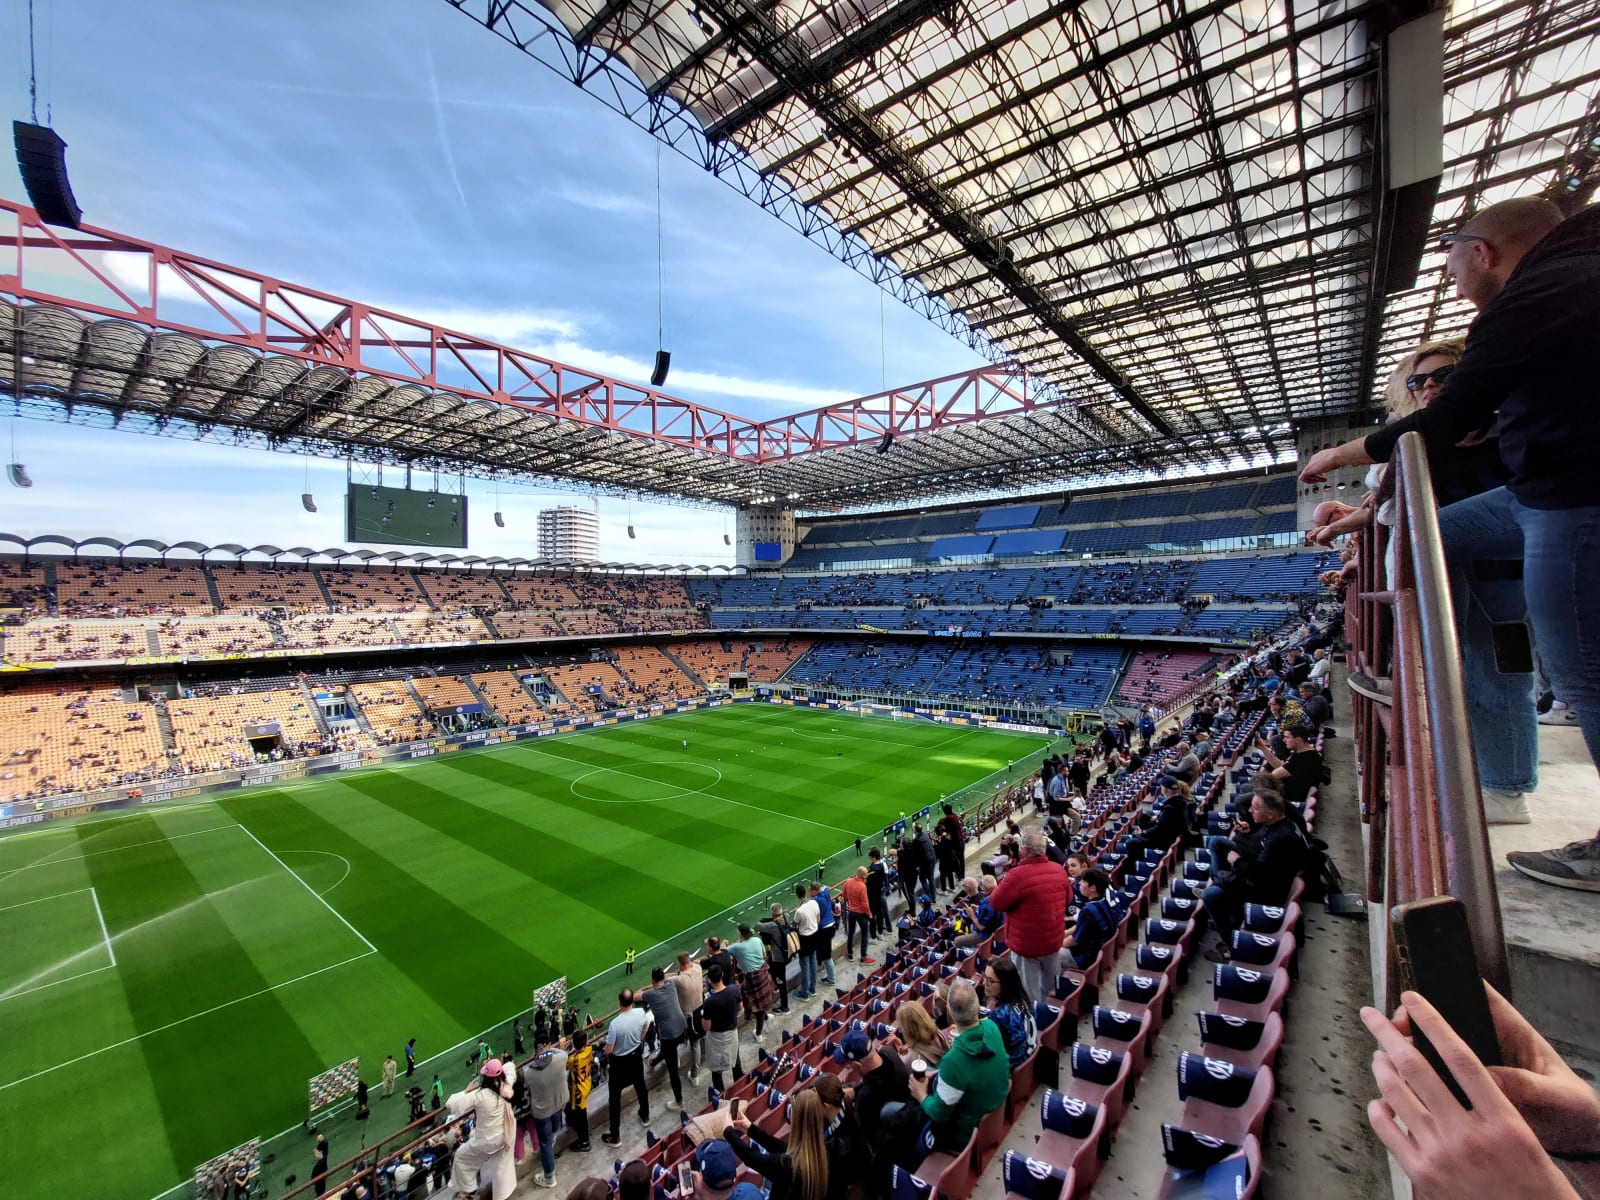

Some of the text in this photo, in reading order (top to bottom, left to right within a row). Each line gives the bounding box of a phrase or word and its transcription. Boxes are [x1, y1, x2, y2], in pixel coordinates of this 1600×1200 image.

[339, 761, 361, 771] SPECIAL
[250, 777, 264, 786] PART
[142, 787, 201, 804] SPECIAL RECORD
[52, 796, 86, 808] SPECIAL
[9, 815, 32, 826] PART
[33, 813, 45, 823] OF
